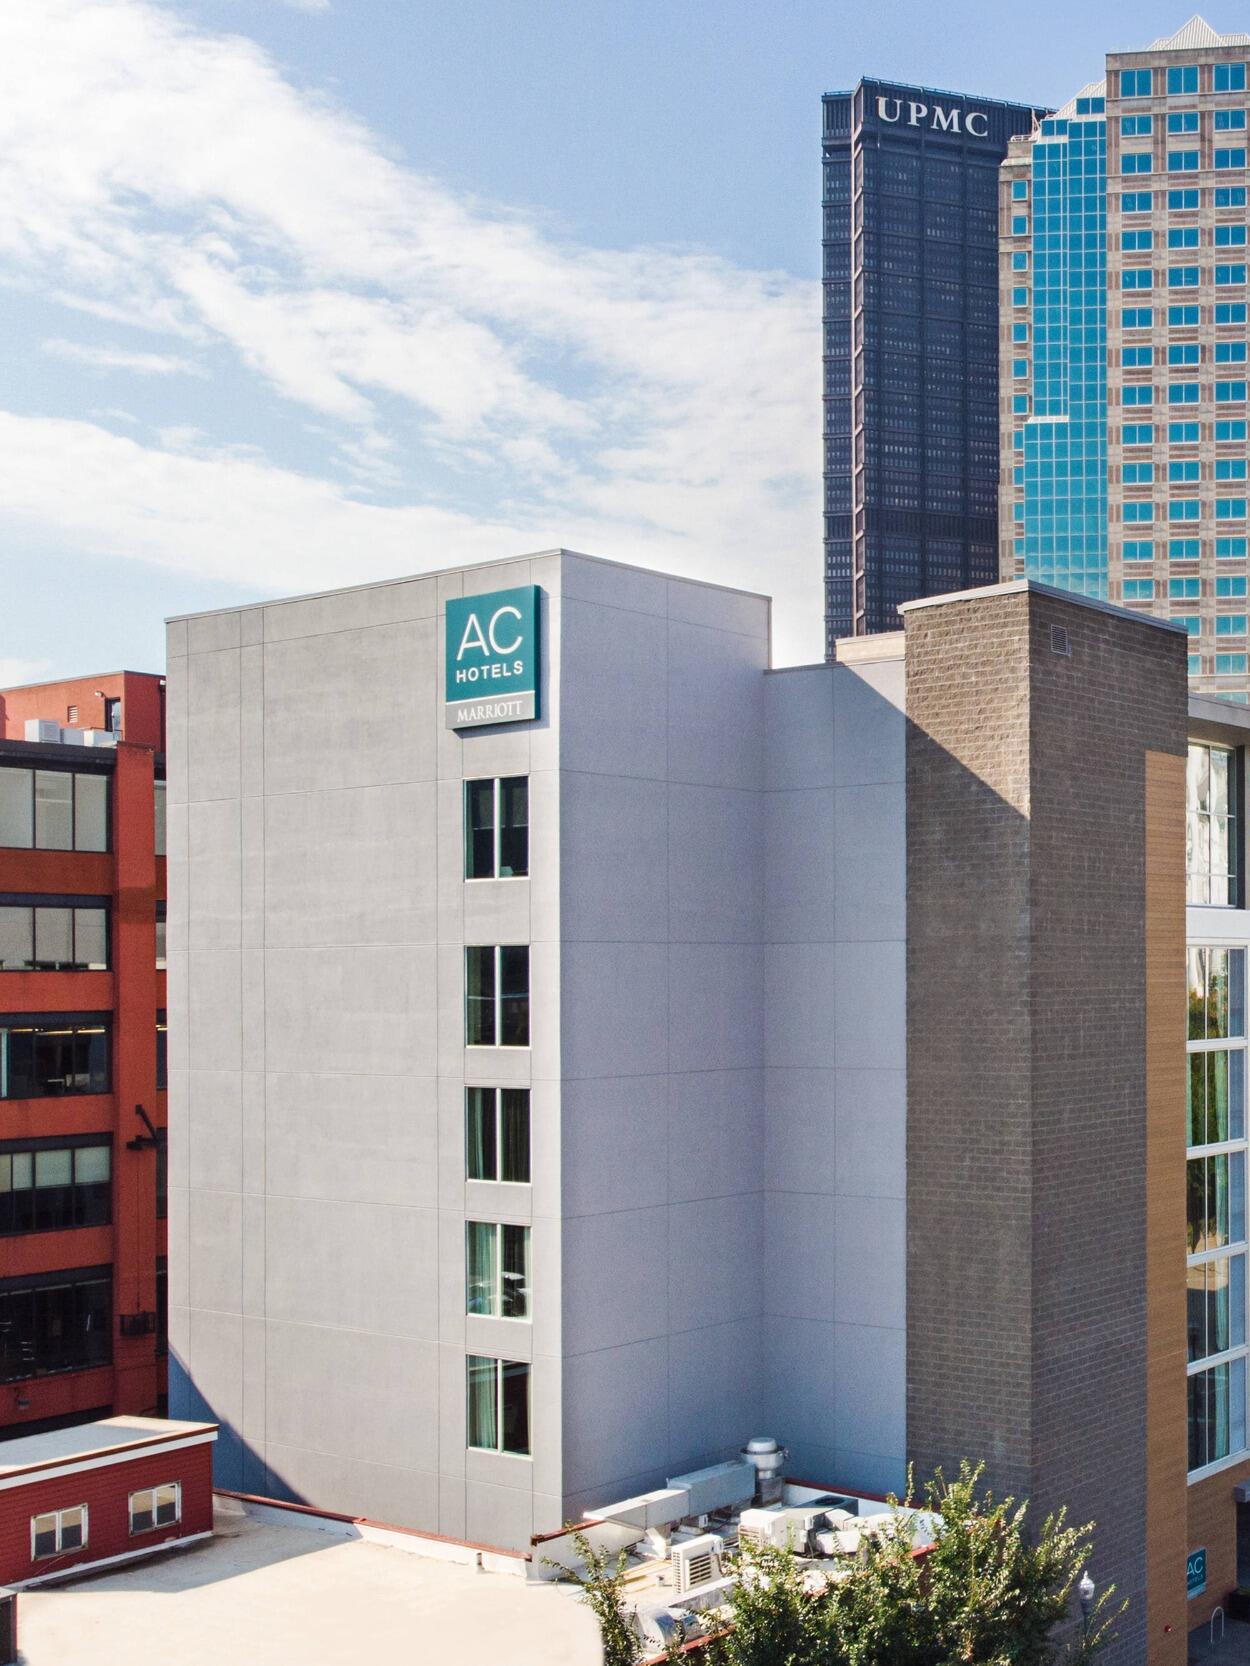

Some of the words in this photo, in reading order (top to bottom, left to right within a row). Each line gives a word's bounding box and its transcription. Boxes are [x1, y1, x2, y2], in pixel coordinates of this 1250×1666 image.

[875, 96, 988, 137] UPMC
[456, 606, 523, 661] AC
[456, 660, 524, 683] HOTELS
[457, 700, 523, 722] MARRIOTT
[1187, 1556, 1203, 1575] AC
